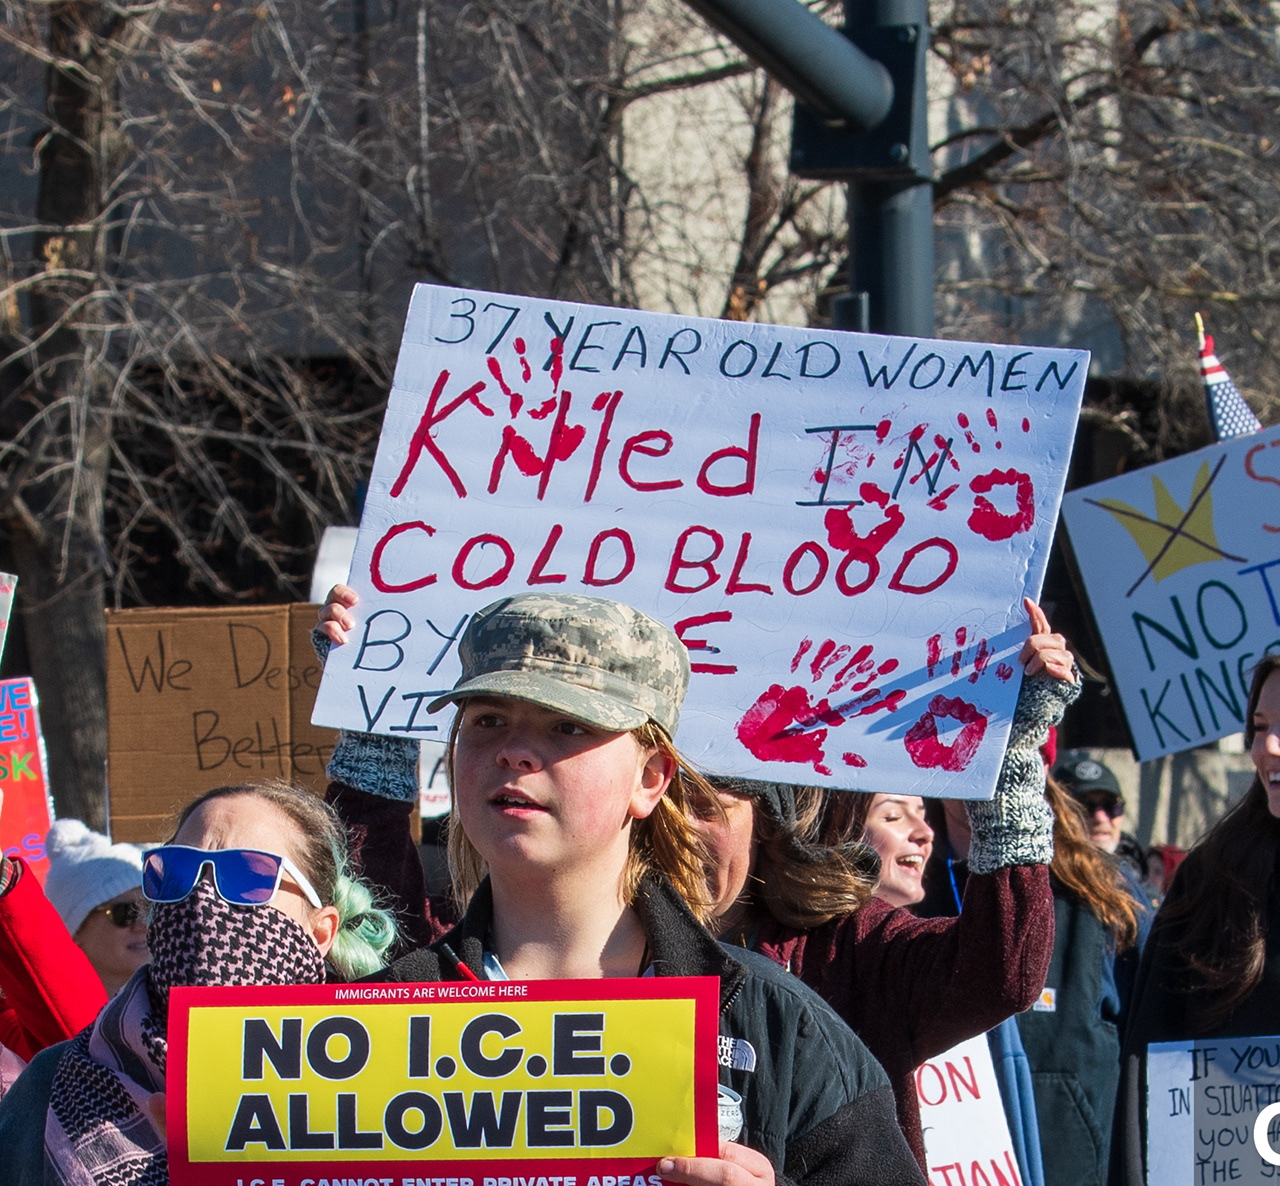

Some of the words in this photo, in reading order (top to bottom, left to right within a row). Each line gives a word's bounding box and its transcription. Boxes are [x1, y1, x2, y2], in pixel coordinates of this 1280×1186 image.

[434, 297, 521, 354] 37
[544, 310, 702, 376] YEAR
[720, 338, 841, 381] OLD
[858, 342, 1079, 397] WOMEN
[370, 519, 637, 593] COLD
[666, 525, 959, 597] BLOOD
[1131, 579, 1249, 673] NO
[116, 626, 194, 693] We
[335, 987, 410, 1000] IMMIGRANTS
[412, 986, 436, 999] ARE
[437, 985, 496, 999] WELCOME
[498, 985, 528, 997] HERE
[241, 1014, 371, 1081] NO
[407, 1011, 633, 1080] I.C.E.
[1187, 1047, 1218, 1081] IF
[1230, 1043, 1280, 1074] YOU
[223, 1088, 635, 1152] ALLOWED
[1168, 1086, 1191, 1117] IN
[1196, 1158, 1242, 1186] THE
